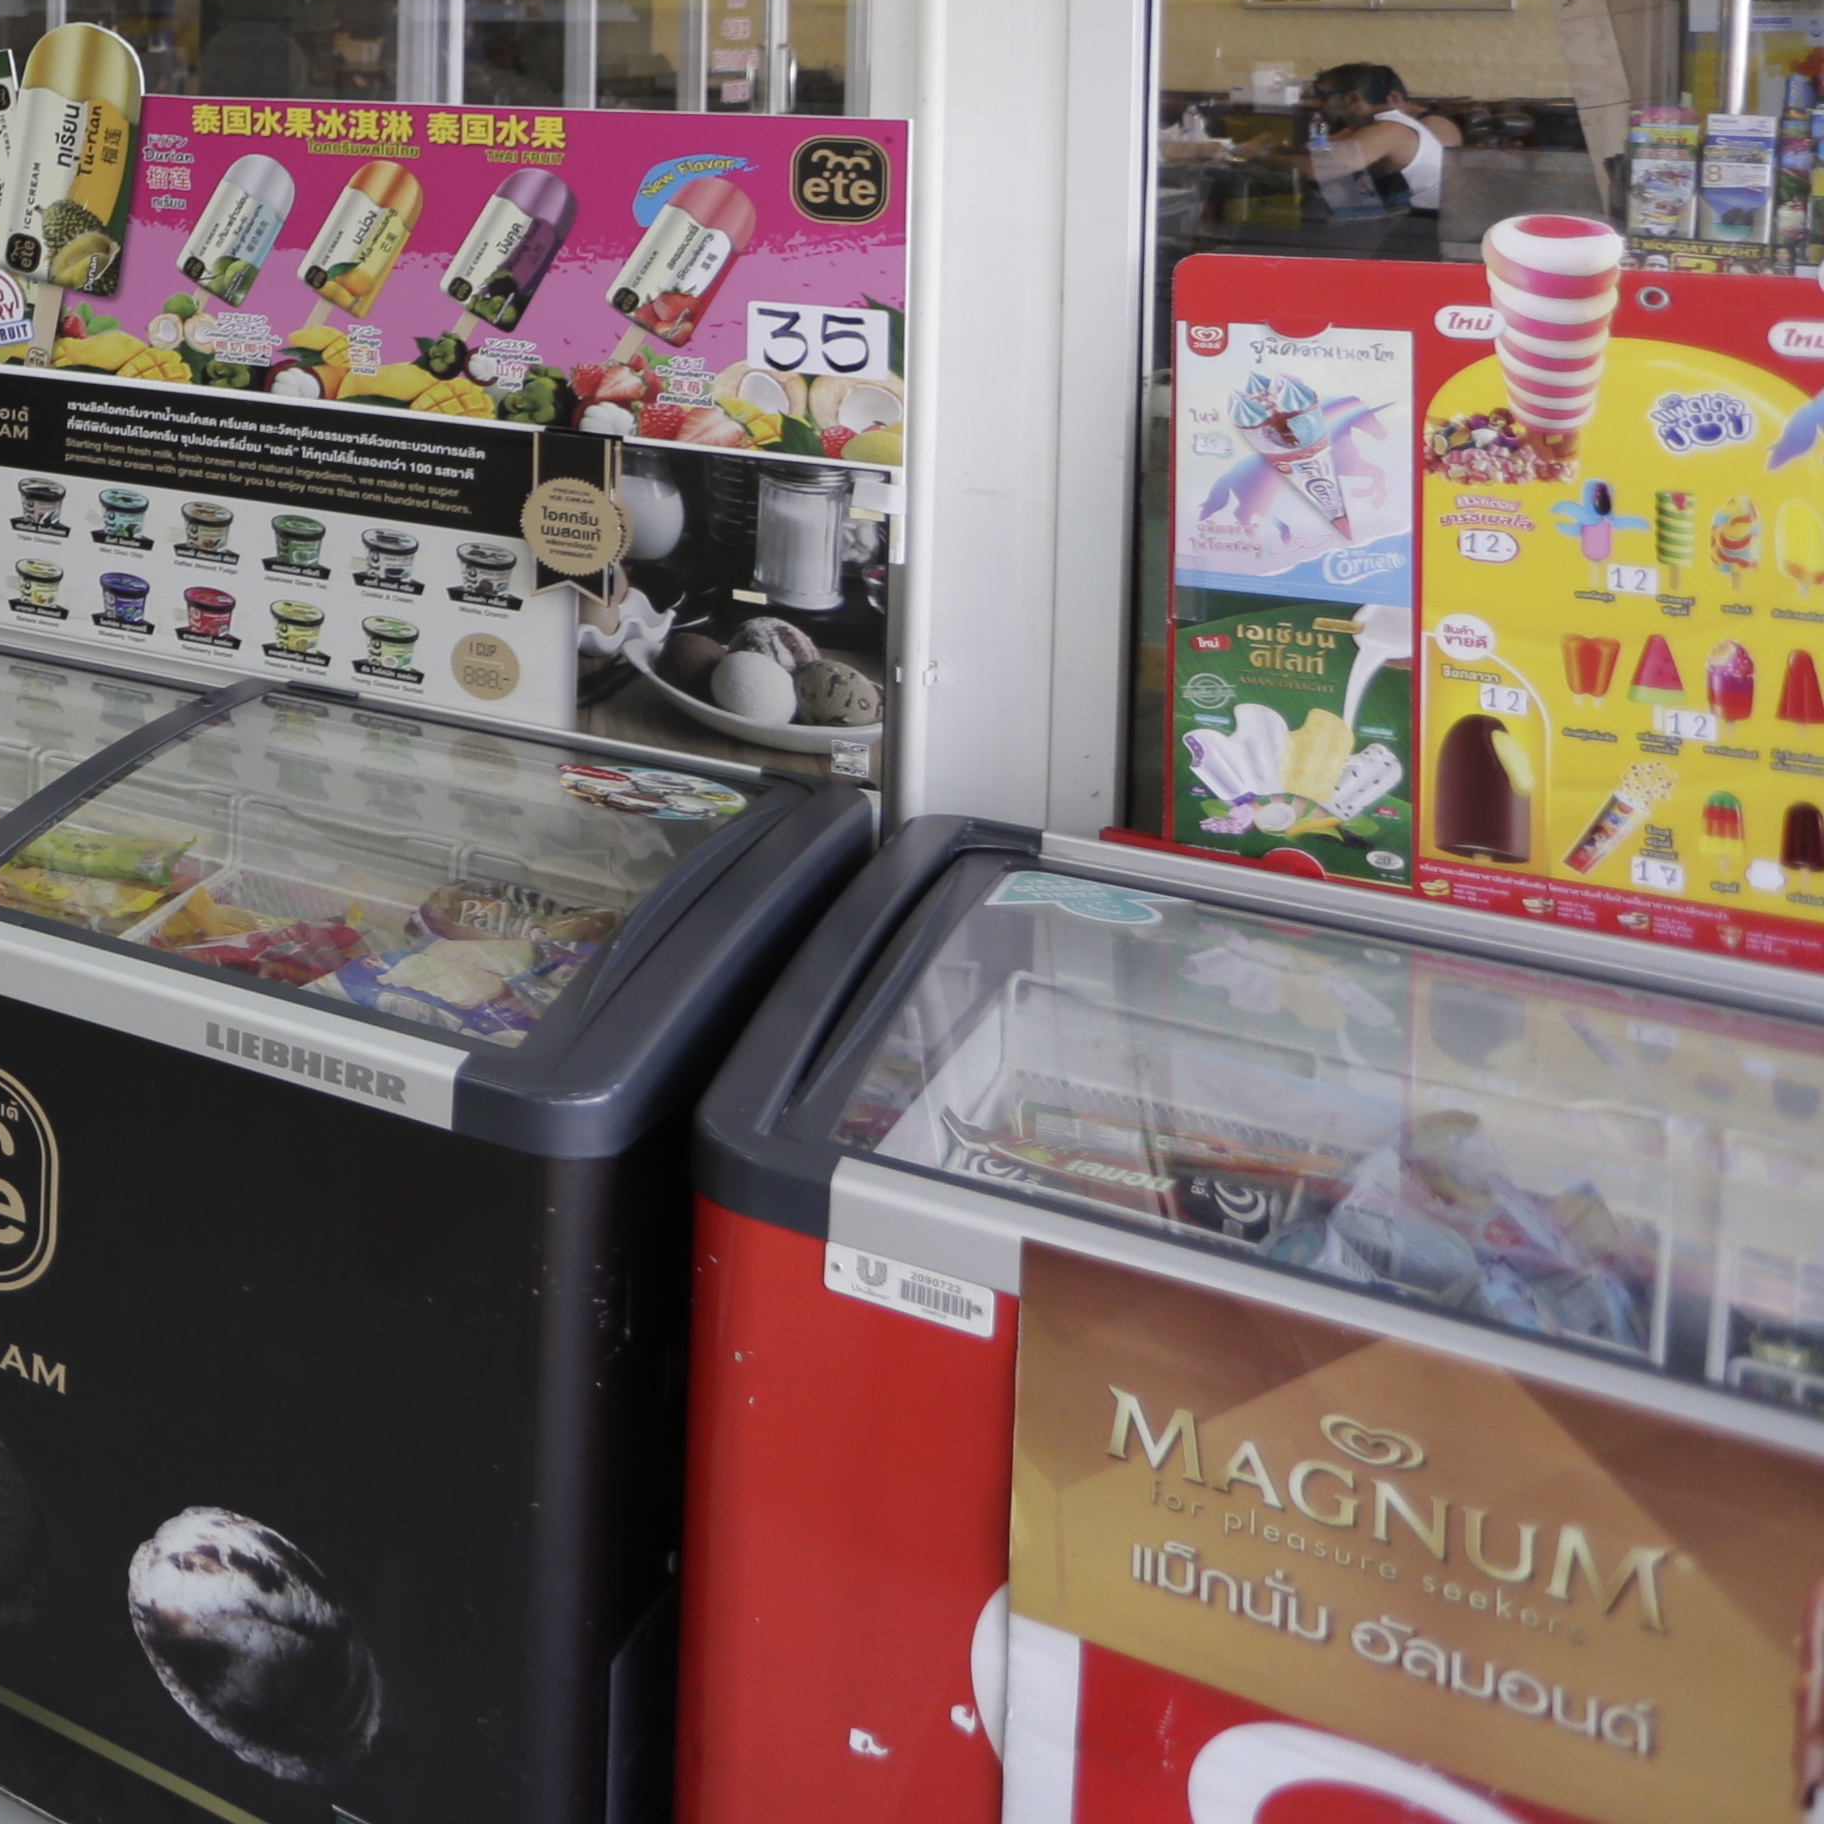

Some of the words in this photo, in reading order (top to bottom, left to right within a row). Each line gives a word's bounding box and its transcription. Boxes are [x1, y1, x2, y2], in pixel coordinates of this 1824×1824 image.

[55, 103, 82, 169] ทุเรียน
[76, 104, 103, 178] Tu-rian
[190, 102, 414, 144] 泰国水果冰淇淋
[426, 112, 567, 150] 泰国水果
[640, 172, 676, 201] New
[802, 171, 878, 206] ete
[1448, 311, 1496, 332] ใหม่
[755, 306, 870, 374] 35
[383, 491, 430, 510] hundred
[541, 505, 600, 527] ไอศกรีม
[540, 523, 602, 542] นมสดแท้
[1321, 548, 1406, 586] Cornetto
[1611, 567, 1648, 592] 12
[1236, 622, 1337, 649] เอเชียน
[1248, 643, 1326, 676] ดิไลท์
[1482, 687, 1521, 711] 12
[1668, 712, 1707, 738] 12
[1635, 859, 1680, 885] 17
[205, 1021, 408, 1106] LIEBHERR
[909, 1270, 963, 1295] 2090722
[1106, 1383, 1676, 1635] MAGNUM
[1150, 1479, 1204, 1518] for
[1223, 1505, 1399, 1582] pleasure
[1422, 1573, 1587, 1644] seekers
[1132, 1539, 1331, 1644] แม็กนั่ม
[1352, 1594, 1658, 1759] อัลมอนด์
